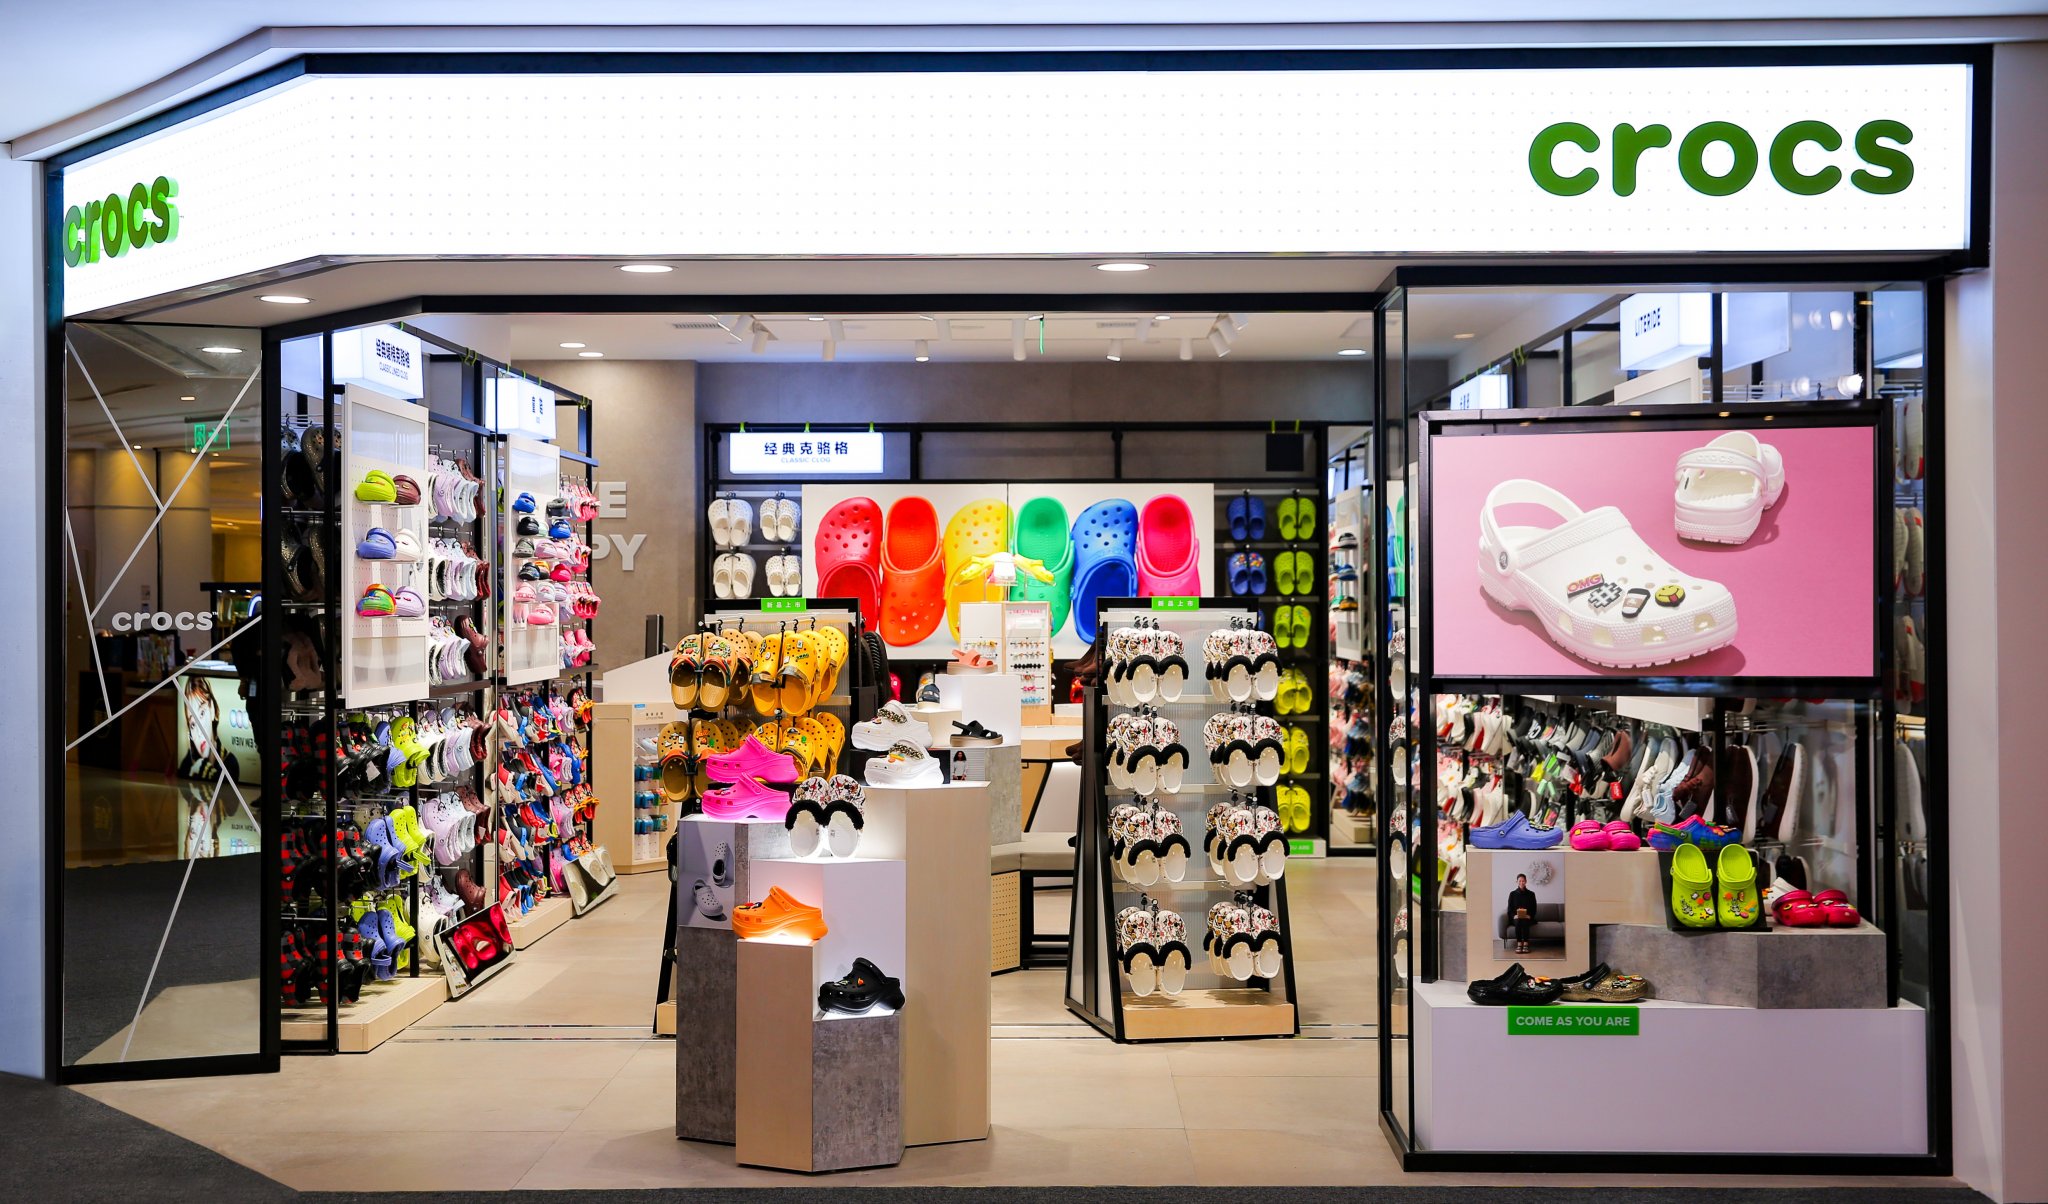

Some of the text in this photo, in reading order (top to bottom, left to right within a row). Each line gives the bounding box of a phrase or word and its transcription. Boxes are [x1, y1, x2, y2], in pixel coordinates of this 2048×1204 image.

[1528, 119, 1915, 197] crocs
[63, 176, 178, 268] crocs
[1634, 306, 1661, 337] LITERIDE
[764, 441, 849, 455] 经典克骆格
[1567, 573, 1602, 592] OMG
[1516, 1016, 1630, 1026] COME AS YOU ARE
